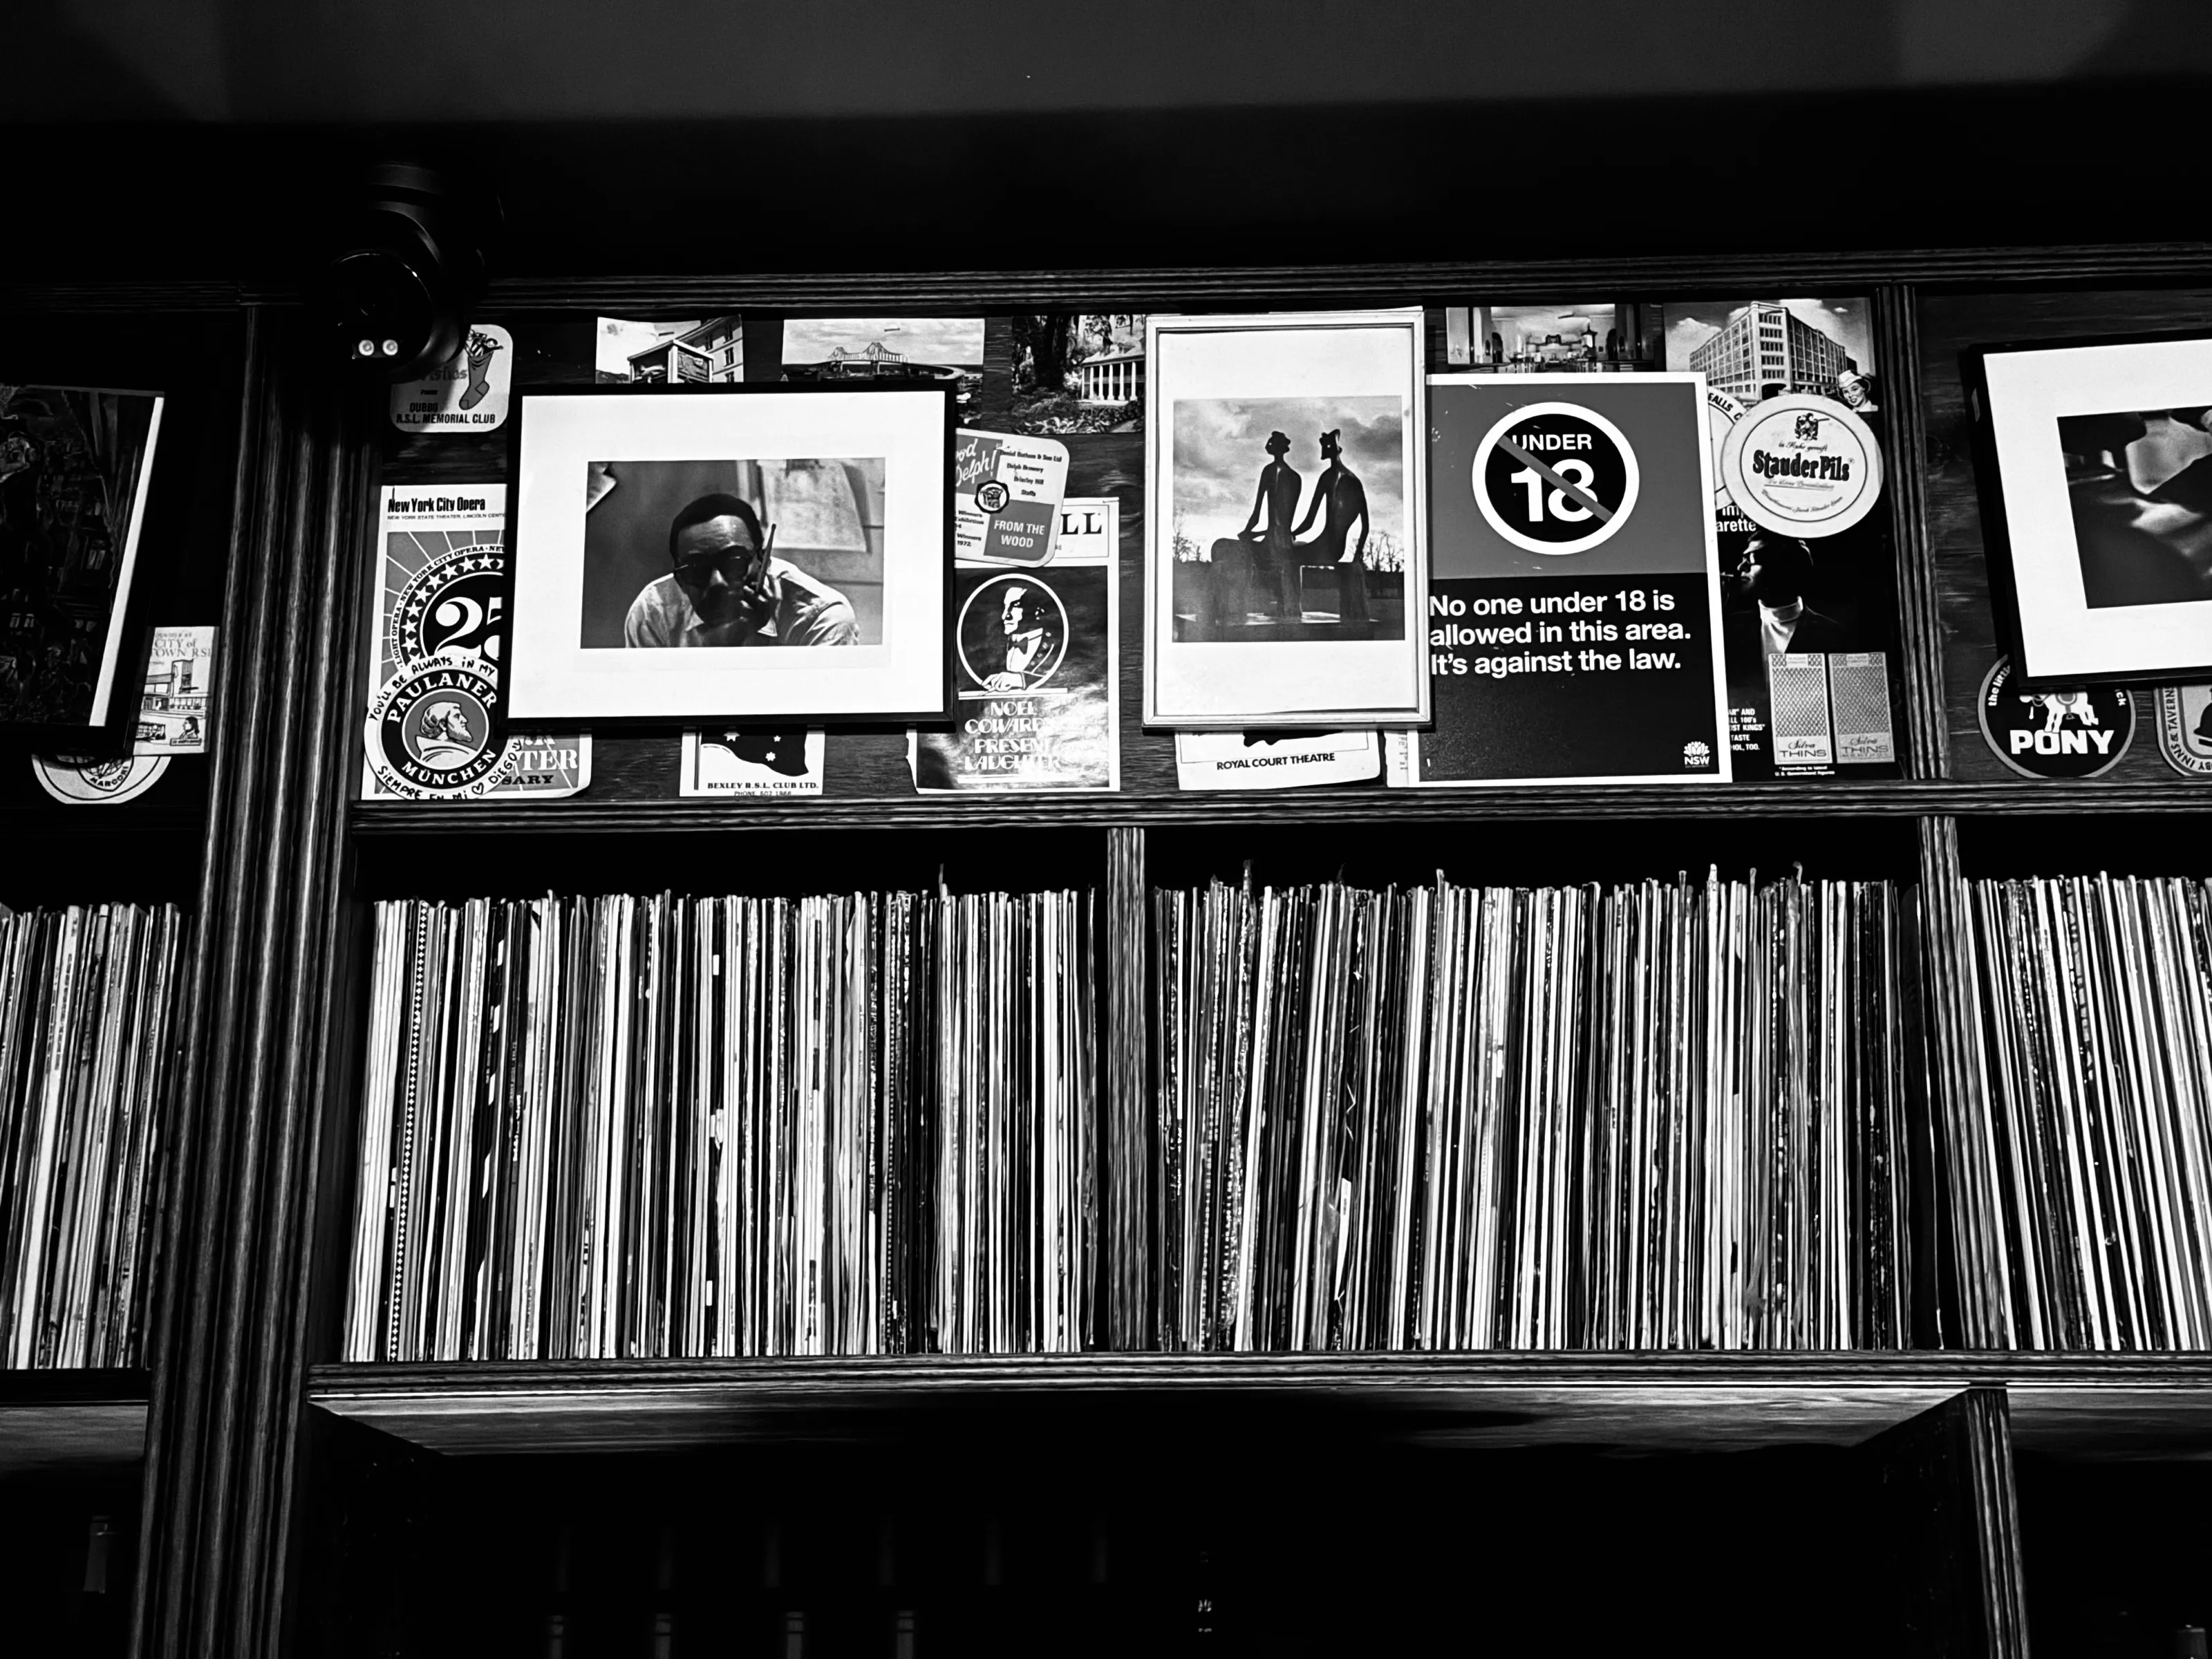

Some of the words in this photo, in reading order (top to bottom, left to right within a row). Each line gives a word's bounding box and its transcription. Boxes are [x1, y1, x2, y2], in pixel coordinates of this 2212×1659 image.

[422, 413, 470, 424] MEMORIAL
[472, 413, 496, 424] CLUB
[1512, 433, 1592, 451] UNDER
[1511, 459, 1598, 523] 18
[388, 498, 410, 513] New
[411, 498, 434, 512] York
[436, 496, 455, 512] City
[457, 496, 485, 512] Opera
[993, 520, 1024, 534] FROM
[1026, 523, 1045, 535] THE
[1716, 518, 1756, 532] arette
[1001, 534, 1033, 547] WOOD
[434, 553, 453, 567] CITY
[454, 545, 485, 557] OPERA
[414, 564, 433, 583] YORK
[401, 583, 414, 602] NEW
[1430, 595, 1466, 616] No
[1473, 596, 1523, 615] one
[1530, 592, 1608, 613] under
[1615, 590, 1646, 611] 18
[1653, 590, 1675, 610] is
[391, 606, 402, 637] OPERA
[1430, 626, 1531, 646] allowed
[1539, 622, 1563, 643] in
[1568, 620, 1618, 641] this
[1625, 620, 1691, 641] area.
[154, 639, 184, 648] CITY
[186, 639, 196, 648] of
[391, 637, 403, 666] LIGHT
[1474, 652, 1573, 679] against
[1579, 650, 1622, 671] the
[1629, 648, 1681, 669] law.
[392, 675, 407, 689] BE
[411, 657, 453, 675] ALWAYS
[479, 664, 495, 677] MY
[387, 673, 497, 723] PAULANER
[1988, 687, 1999, 706] the
[991, 701, 1037, 716] NOEL
[2164, 688, 2177, 731] TAVERN
[965, 718, 1046, 735] COWARD
[1840, 745, 1888, 754] THINS
[2010, 730, 2115, 755] PONY
[1217, 760, 1250, 770] ROYAL
[1252, 756, 1287, 767] COURT
[1290, 752, 1335, 764] THEATRE
[1685, 756, 1709, 765] NSW
[1779, 749, 1827, 758] THINS
[2171, 743, 2195, 768] INNS
[401, 749, 496, 785] MÜNCHEN
